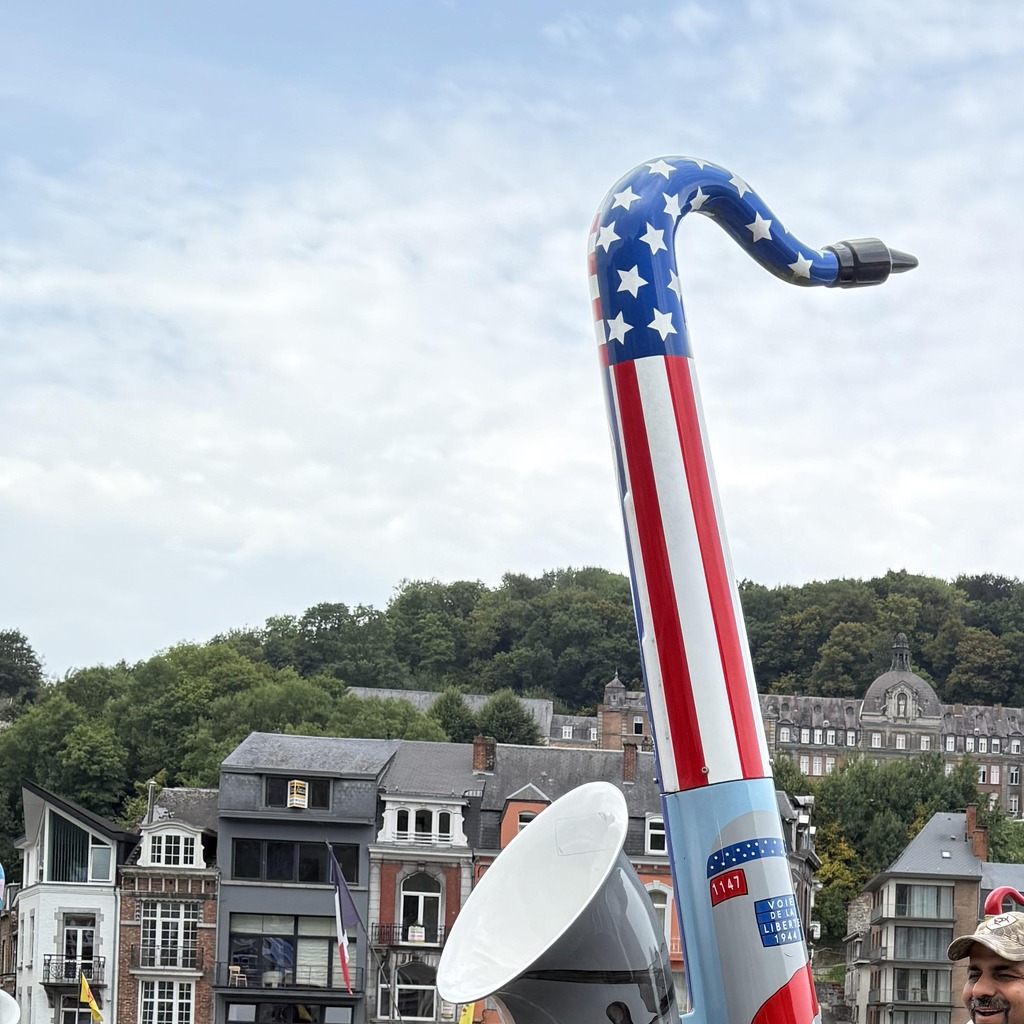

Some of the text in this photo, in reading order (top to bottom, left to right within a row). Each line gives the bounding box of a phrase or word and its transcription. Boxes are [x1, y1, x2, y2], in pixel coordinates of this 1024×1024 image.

[712, 875, 740, 896] 1147
[767, 898, 794, 910] VOIE
[770, 909, 795, 920] DE LA
[774, 931, 798, 944] 1944
